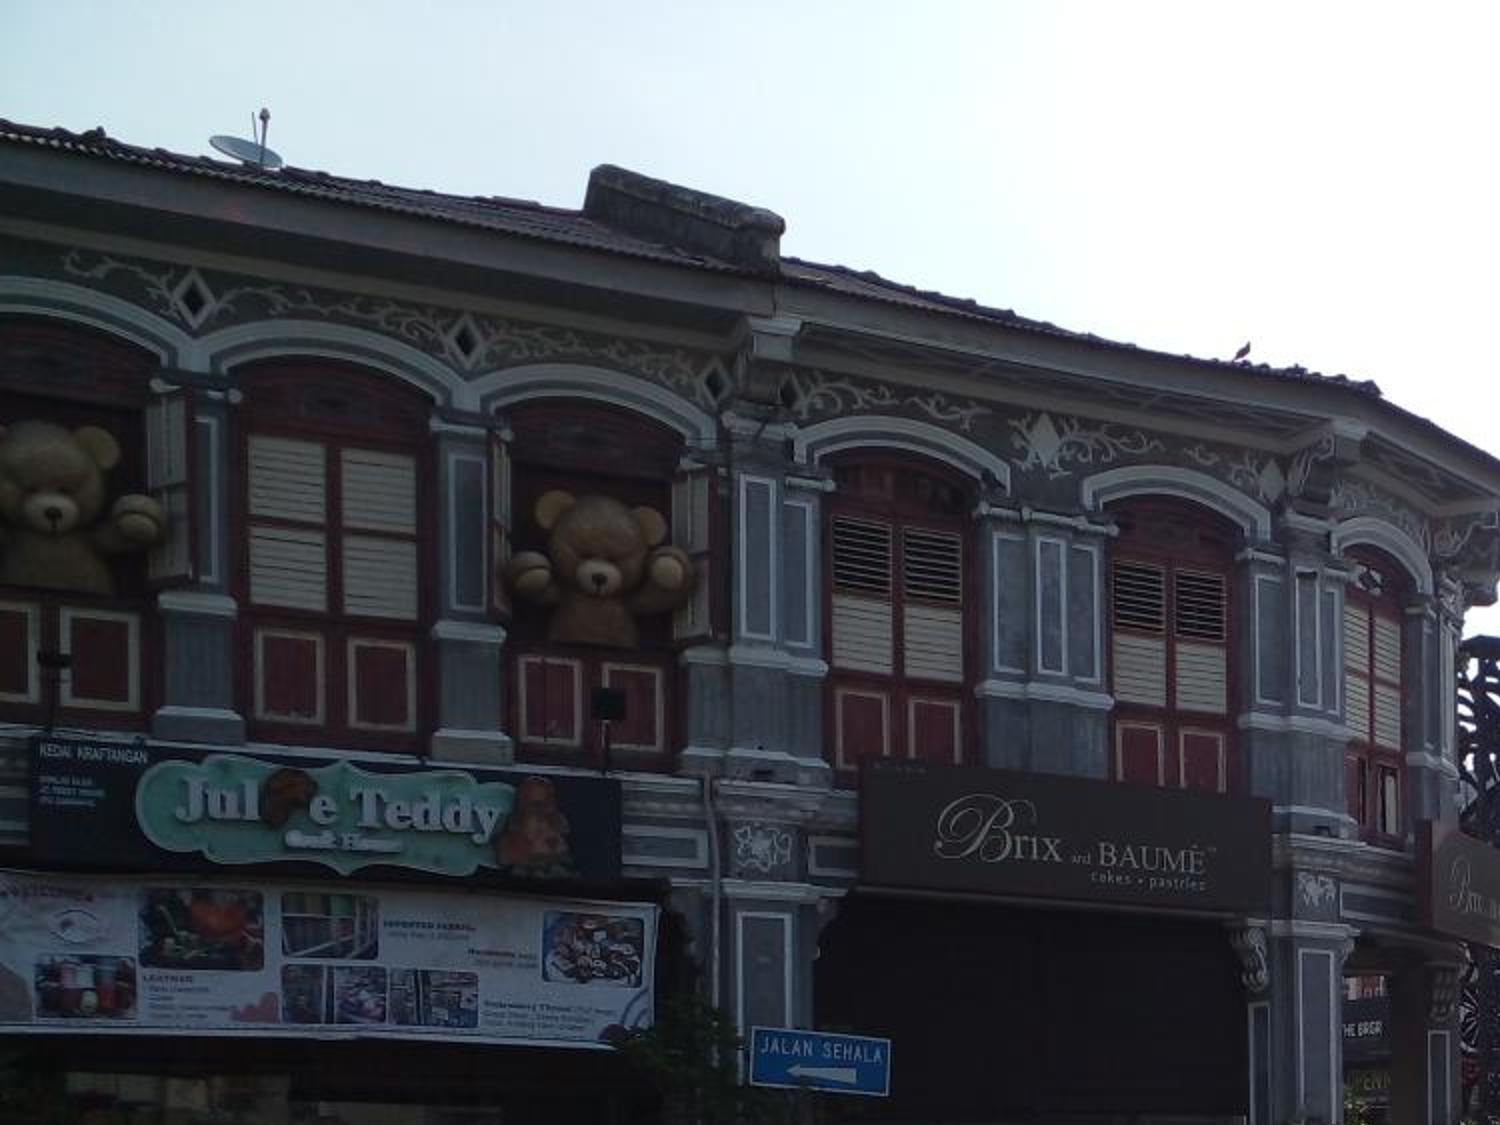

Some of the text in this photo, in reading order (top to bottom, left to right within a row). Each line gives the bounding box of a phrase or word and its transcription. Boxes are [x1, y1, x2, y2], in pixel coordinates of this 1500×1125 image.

[175, 775, 338, 827] Jule
[350, 783, 503, 845] Teddy
[932, 792, 1063, 864] Brix
[760, 1035, 884, 1065] JALAN SEHALA
